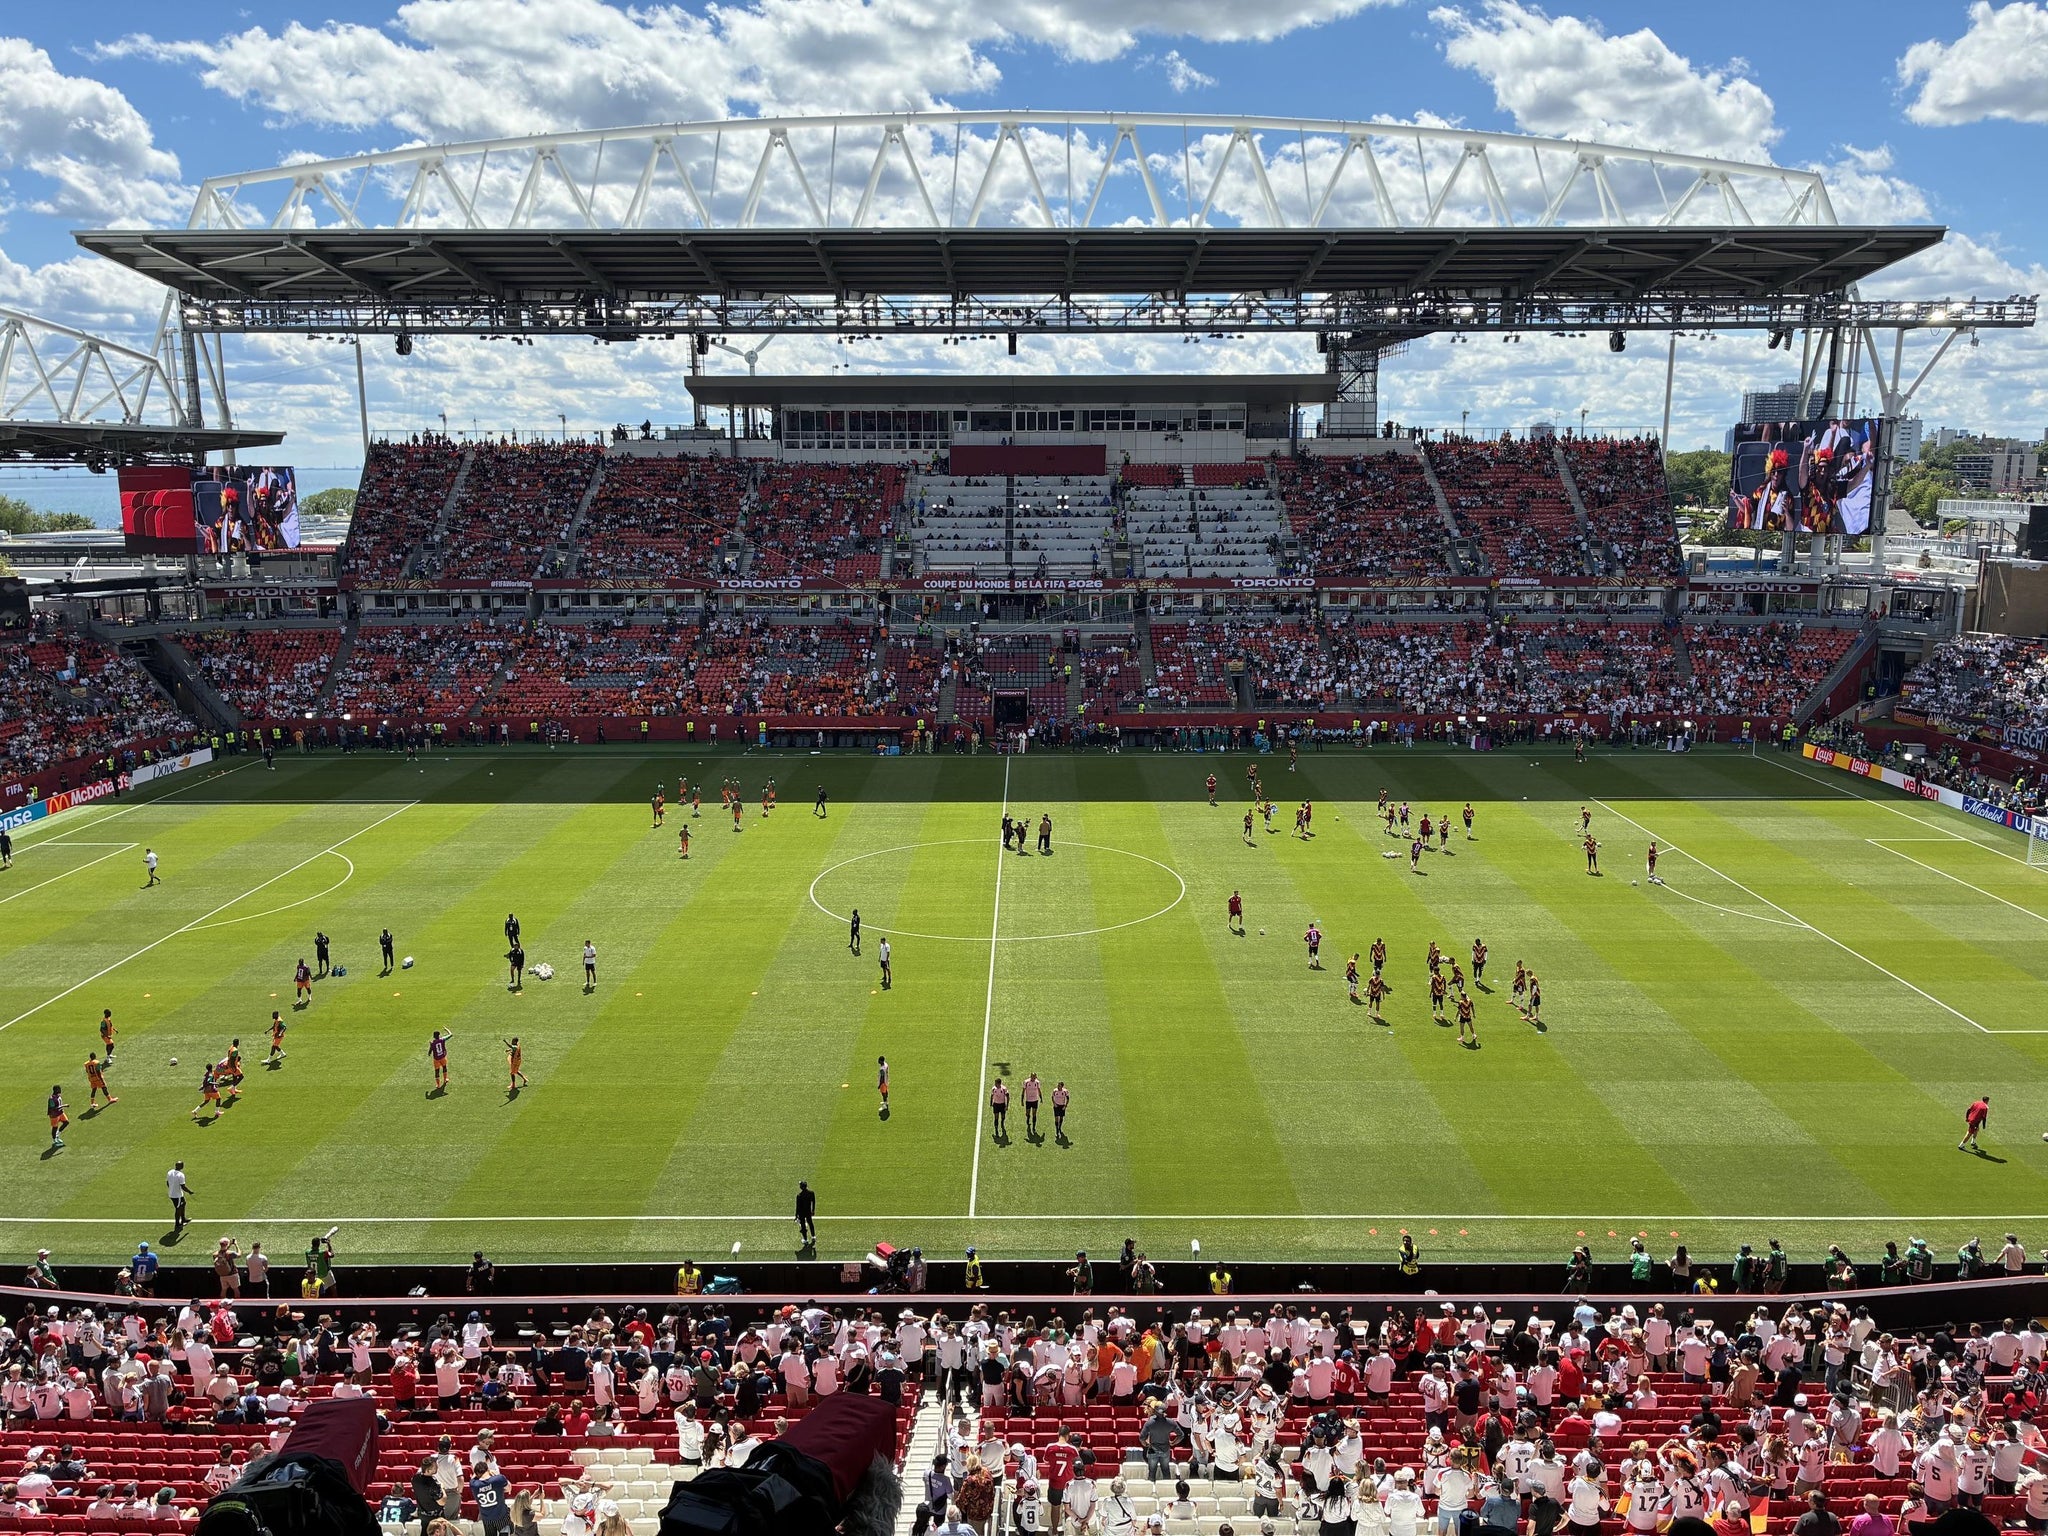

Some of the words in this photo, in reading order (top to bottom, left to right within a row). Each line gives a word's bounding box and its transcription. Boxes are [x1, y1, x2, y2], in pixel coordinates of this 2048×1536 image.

[717, 580, 801, 588] TORONTO
[923, 580, 957, 588] COUPE
[958, 580, 973, 588] DU
[974, 580, 1011, 588] MONDE
[1014, 580, 1028, 588] DE
[1029, 580, 1042, 588] LA
[1043, 580, 1066, 588] FIFA
[1067, 580, 1104, 588] 2026
[1230, 578, 1316, 587] TORONTO
[1707, 582, 1802, 592] TORONTO
[224, 587, 319, 597] TORONTO
[1815, 746, 1834, 763] Lay's
[152, 761, 177, 780] Dove
[1850, 757, 1869, 775] Lay's
[5, 782, 24, 797] FIFA
[71, 773, 131, 806] McDonad's
[1963, 798, 2005, 824] Michelob
[38, 1394, 48, 1408] 7
[1056, 1460, 1068, 1477] 7
[1931, 1466, 1942, 1481] 5
[1974, 1465, 1984, 1481] 5
[477, 1490, 497, 1504] 30
[1639, 1495, 1659, 1512] 17
[1027, 1510, 1036, 1524] 9
